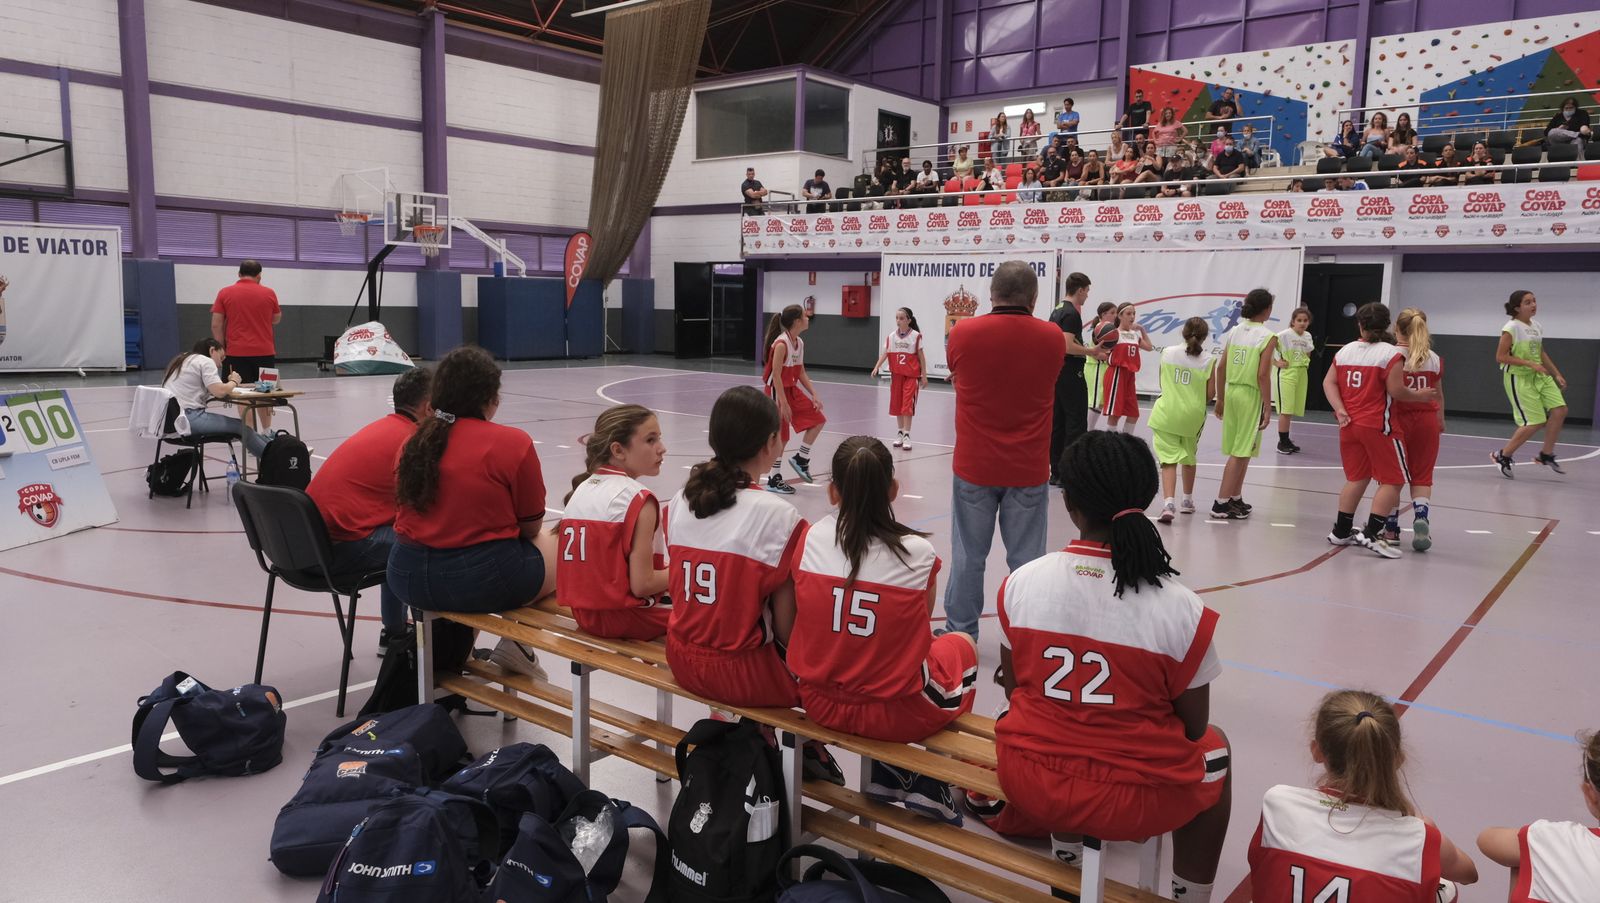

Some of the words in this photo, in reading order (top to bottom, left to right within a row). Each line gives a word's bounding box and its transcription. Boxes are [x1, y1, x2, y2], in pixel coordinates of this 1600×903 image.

[1412, 194, 1443, 205] COPA
[1467, 192, 1501, 203] COPA
[1525, 189, 1561, 201] COPA
[1219, 201, 1245, 211] COPA
[1264, 200, 1291, 210] COPA
[1311, 198, 1340, 208] COPA
[1360, 196, 1390, 207] COPA
[1520, 200, 1567, 211] COVAP
[1026, 208, 1046, 217] COPA
[1061, 207, 1083, 216] COPA
[1097, 206, 1120, 215] COPA
[1136, 204, 1159, 214] COPA
[1177, 203, 1201, 213] COPA
[1307, 207, 1344, 217] COVAP
[1356, 206, 1395, 216] COVAP
[1408, 204, 1448, 215] COVAP
[1463, 202, 1506, 213] COVAP
[898, 214, 916, 222] COPA
[929, 213, 946, 221] COPA
[959, 211, 978, 219] COPA
[992, 210, 1012, 218] COPA
[1094, 214, 1124, 223] COVAP
[1133, 213, 1163, 222] COVAP
[1174, 212, 1205, 221] COVAP
[1216, 210, 1249, 220] COVAP
[1260, 209, 1295, 219] COVAP
[927, 220, 949, 229] COVAP
[957, 219, 981, 227] COVAP
[989, 218, 1015, 226] COVAP
[1023, 216, 1049, 225] COVAP
[1058, 215, 1086, 224] COVAP
[815, 225, 834, 233] COVAP
[841, 224, 861, 232] COVAP
[869, 223, 890, 231] COVAP
[896, 221, 919, 230] COVAP
[3, 236, 29, 254] DE
[36, 237, 108, 256] VIATOR
[568, 236, 589, 288] COVAP
[888, 262, 976, 278] AYUNTAMIENTO
[979, 262, 995, 277] DE
[1233, 349, 1247, 365] 21
[1175, 367, 1192, 385] 10
[1346, 370, 1362, 388] 19
[1406, 375, 1427, 391] 20
[24, 485, 45, 494] COPA
[23, 492, 53, 505] COVAP
[563, 526, 587, 562] 21
[682, 560, 717, 605] 19
[832, 586, 880, 637] 15
[1043, 646, 1115, 705] 22
[671, 848, 707, 887] hummel
[1290, 865, 1351, 903] 14
